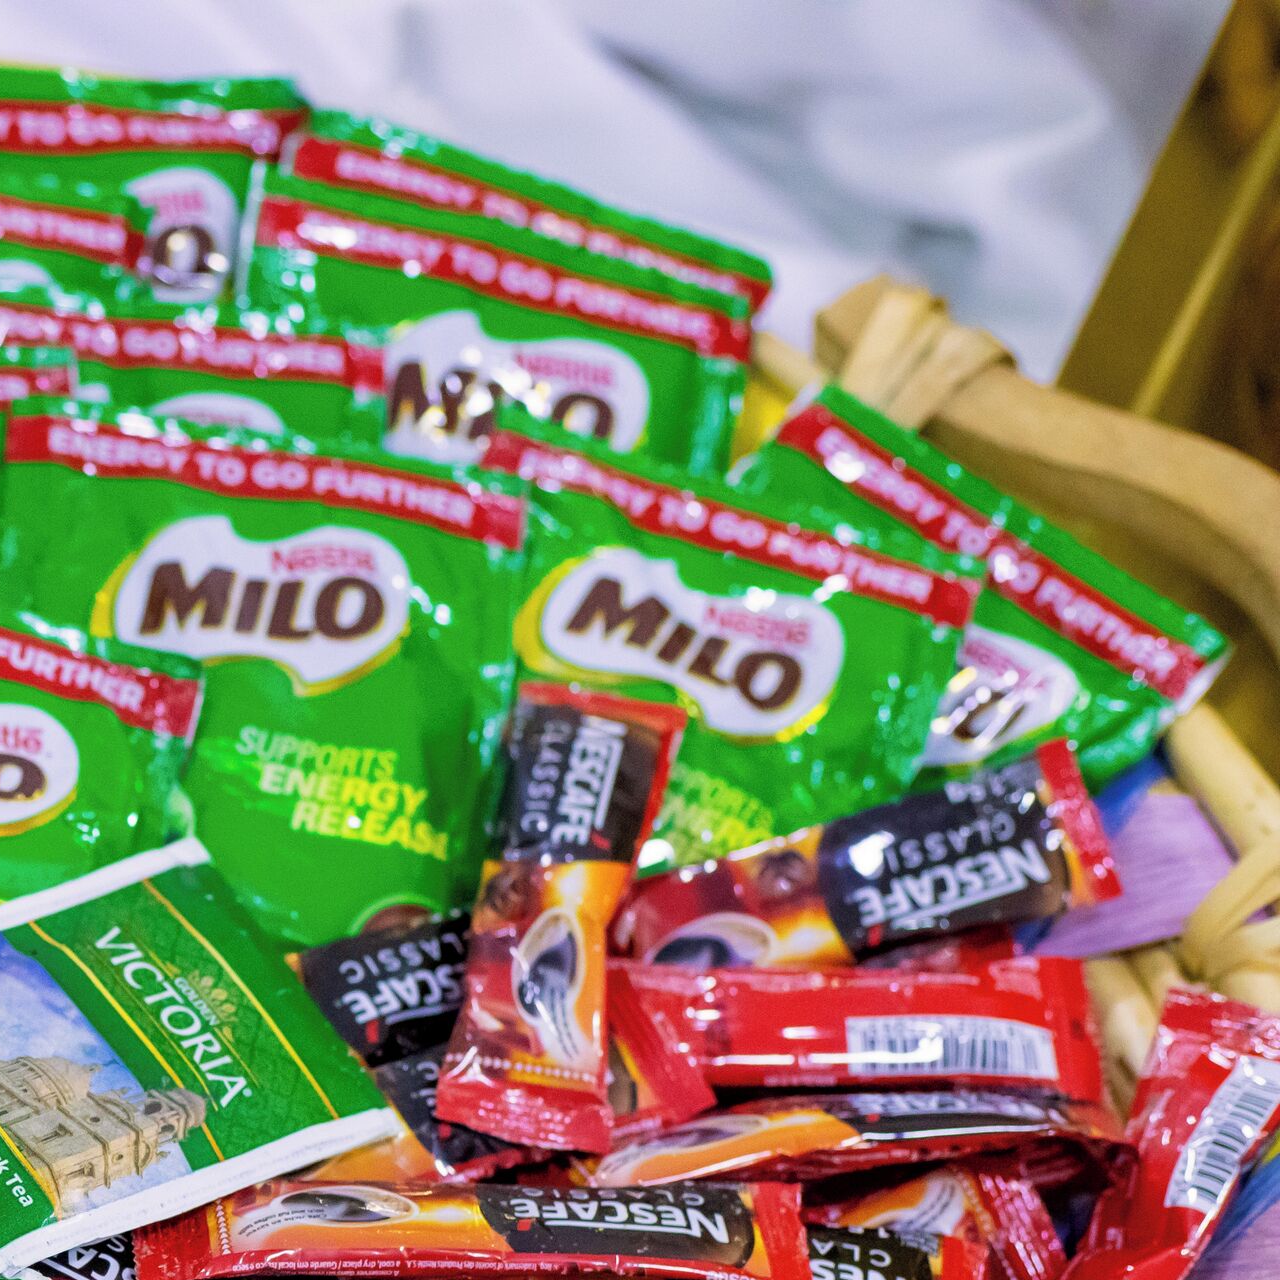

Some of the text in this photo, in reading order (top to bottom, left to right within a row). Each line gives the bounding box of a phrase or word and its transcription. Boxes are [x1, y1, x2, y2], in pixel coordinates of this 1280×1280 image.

[47, 426, 477, 528] ENERGY TO GO FURTHER
[271, 545, 378, 574] Nestlé
[138, 561, 386, 641] MILO
[565, 576, 805, 712] MILO
[236, 725, 400, 779] SUPPORTS
[258, 764, 430, 816] ENERGY
[94, 925, 247, 1109] VICTORIA
[173, 973, 221, 1026] GOLDEN
[4, 1172, 34, 1208] Tea
